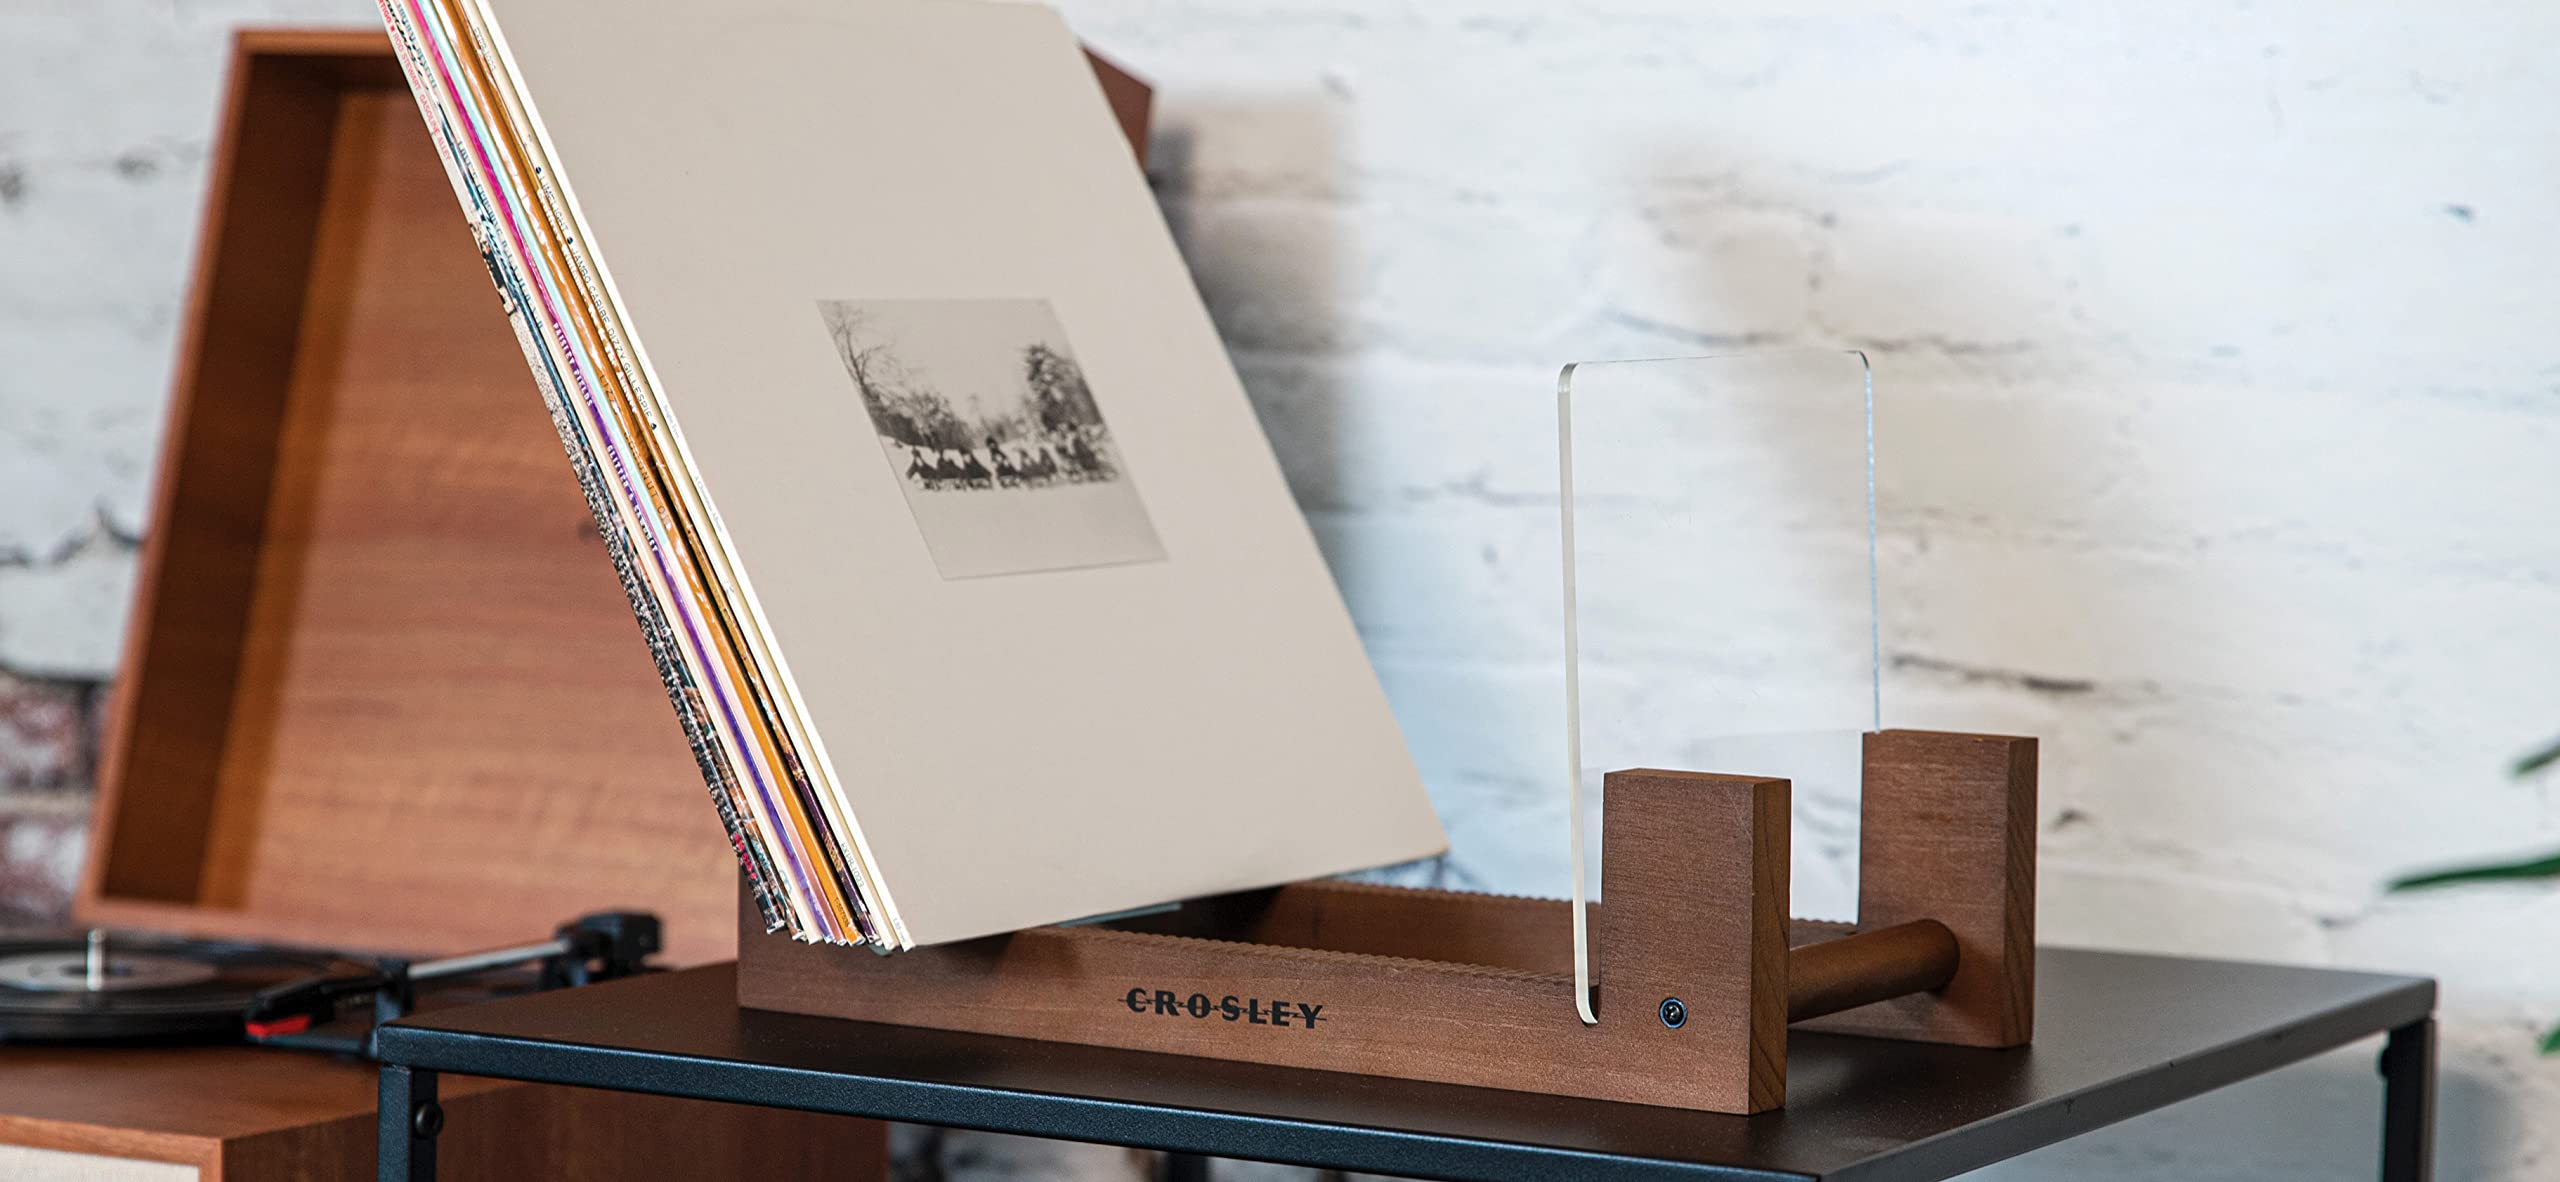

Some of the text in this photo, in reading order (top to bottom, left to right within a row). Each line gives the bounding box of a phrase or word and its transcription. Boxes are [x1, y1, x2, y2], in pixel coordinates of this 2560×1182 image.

[392, 33, 404, 52] ROD
[401, 53, 421, 91] STEWART
[419, 94, 440, 136] GASOLINE
[437, 137, 451, 160] ALLEY
[540, 176, 651, 418] LIMELIGHT JAMBO CARIBE DIZZY GILLESPIE
[552, 322, 592, 406] PAISLEY FIELDS
[607, 445, 630, 488] GLITTER
[624, 431, 658, 497] COCONUT
[1125, 987, 1325, 1030] CROSLEY
